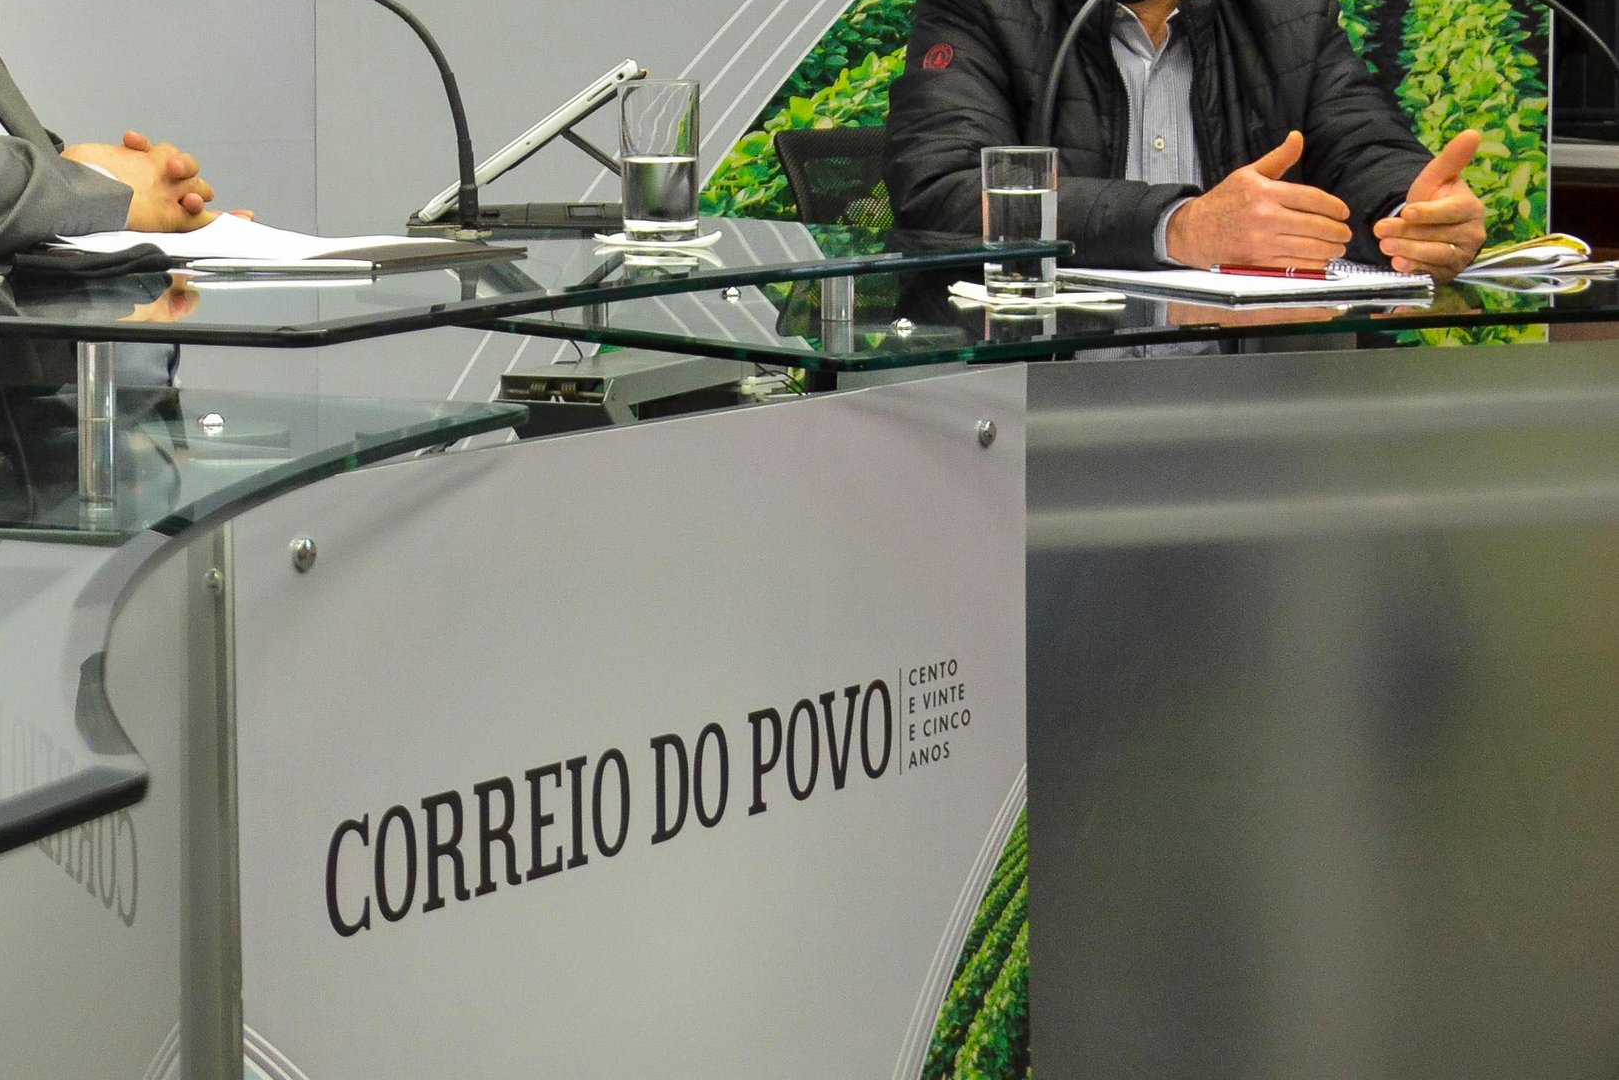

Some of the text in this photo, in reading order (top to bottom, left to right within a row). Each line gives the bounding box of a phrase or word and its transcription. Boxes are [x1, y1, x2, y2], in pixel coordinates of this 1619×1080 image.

[909, 658, 958, 687] CENTO
[909, 683, 965, 714] E VINTE
[909, 708, 971, 742] E CINCO
[908, 741, 950, 769] ANOS
[325, 678, 893, 938] CORREIO DO POVO
